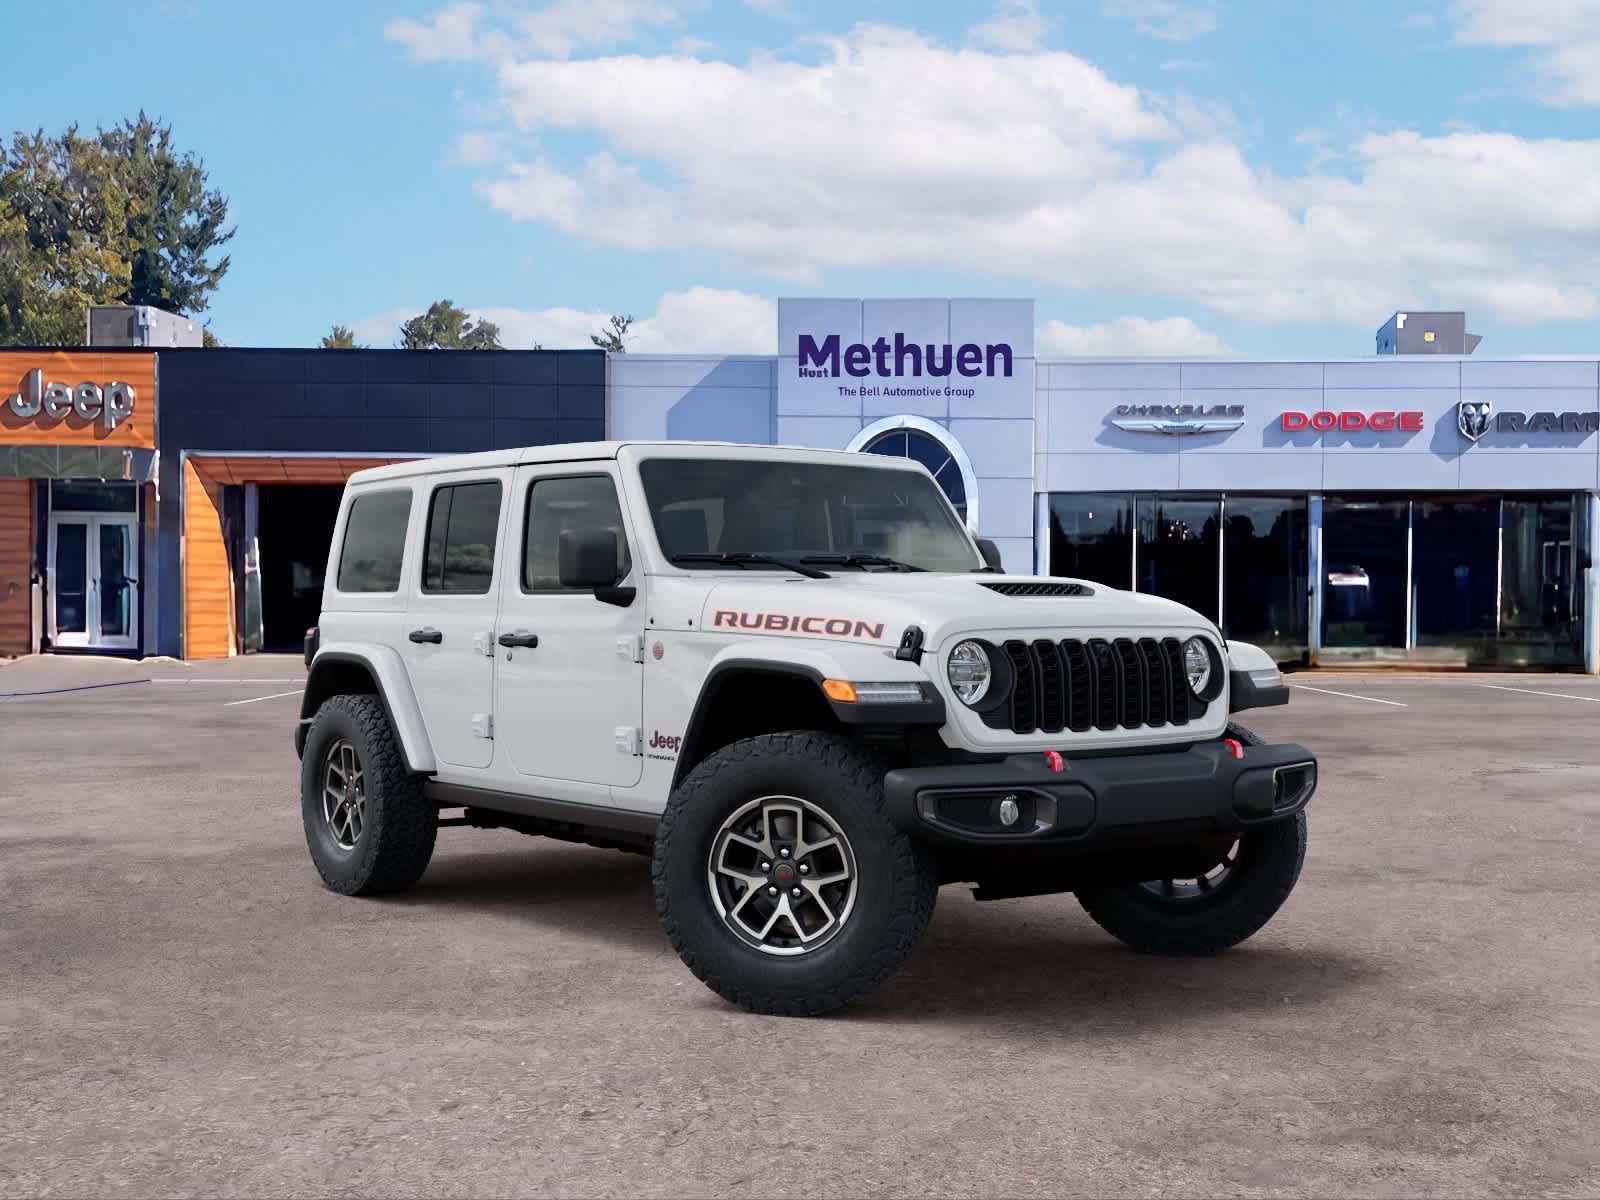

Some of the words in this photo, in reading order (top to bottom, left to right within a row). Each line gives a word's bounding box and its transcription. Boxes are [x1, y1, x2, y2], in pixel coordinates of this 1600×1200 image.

[798, 333, 1013, 378] Methuen
[9, 368, 136, 430] Jeep
[837, 386, 857, 397] The
[859, 386, 881, 397] Bell
[883, 386, 942, 397] Automotive
[944, 386, 975, 399] Group
[1282, 411, 1425, 432] DODGE
[1497, 411, 1600, 433] RAM
[713, 610, 886, 640] RUBICON
